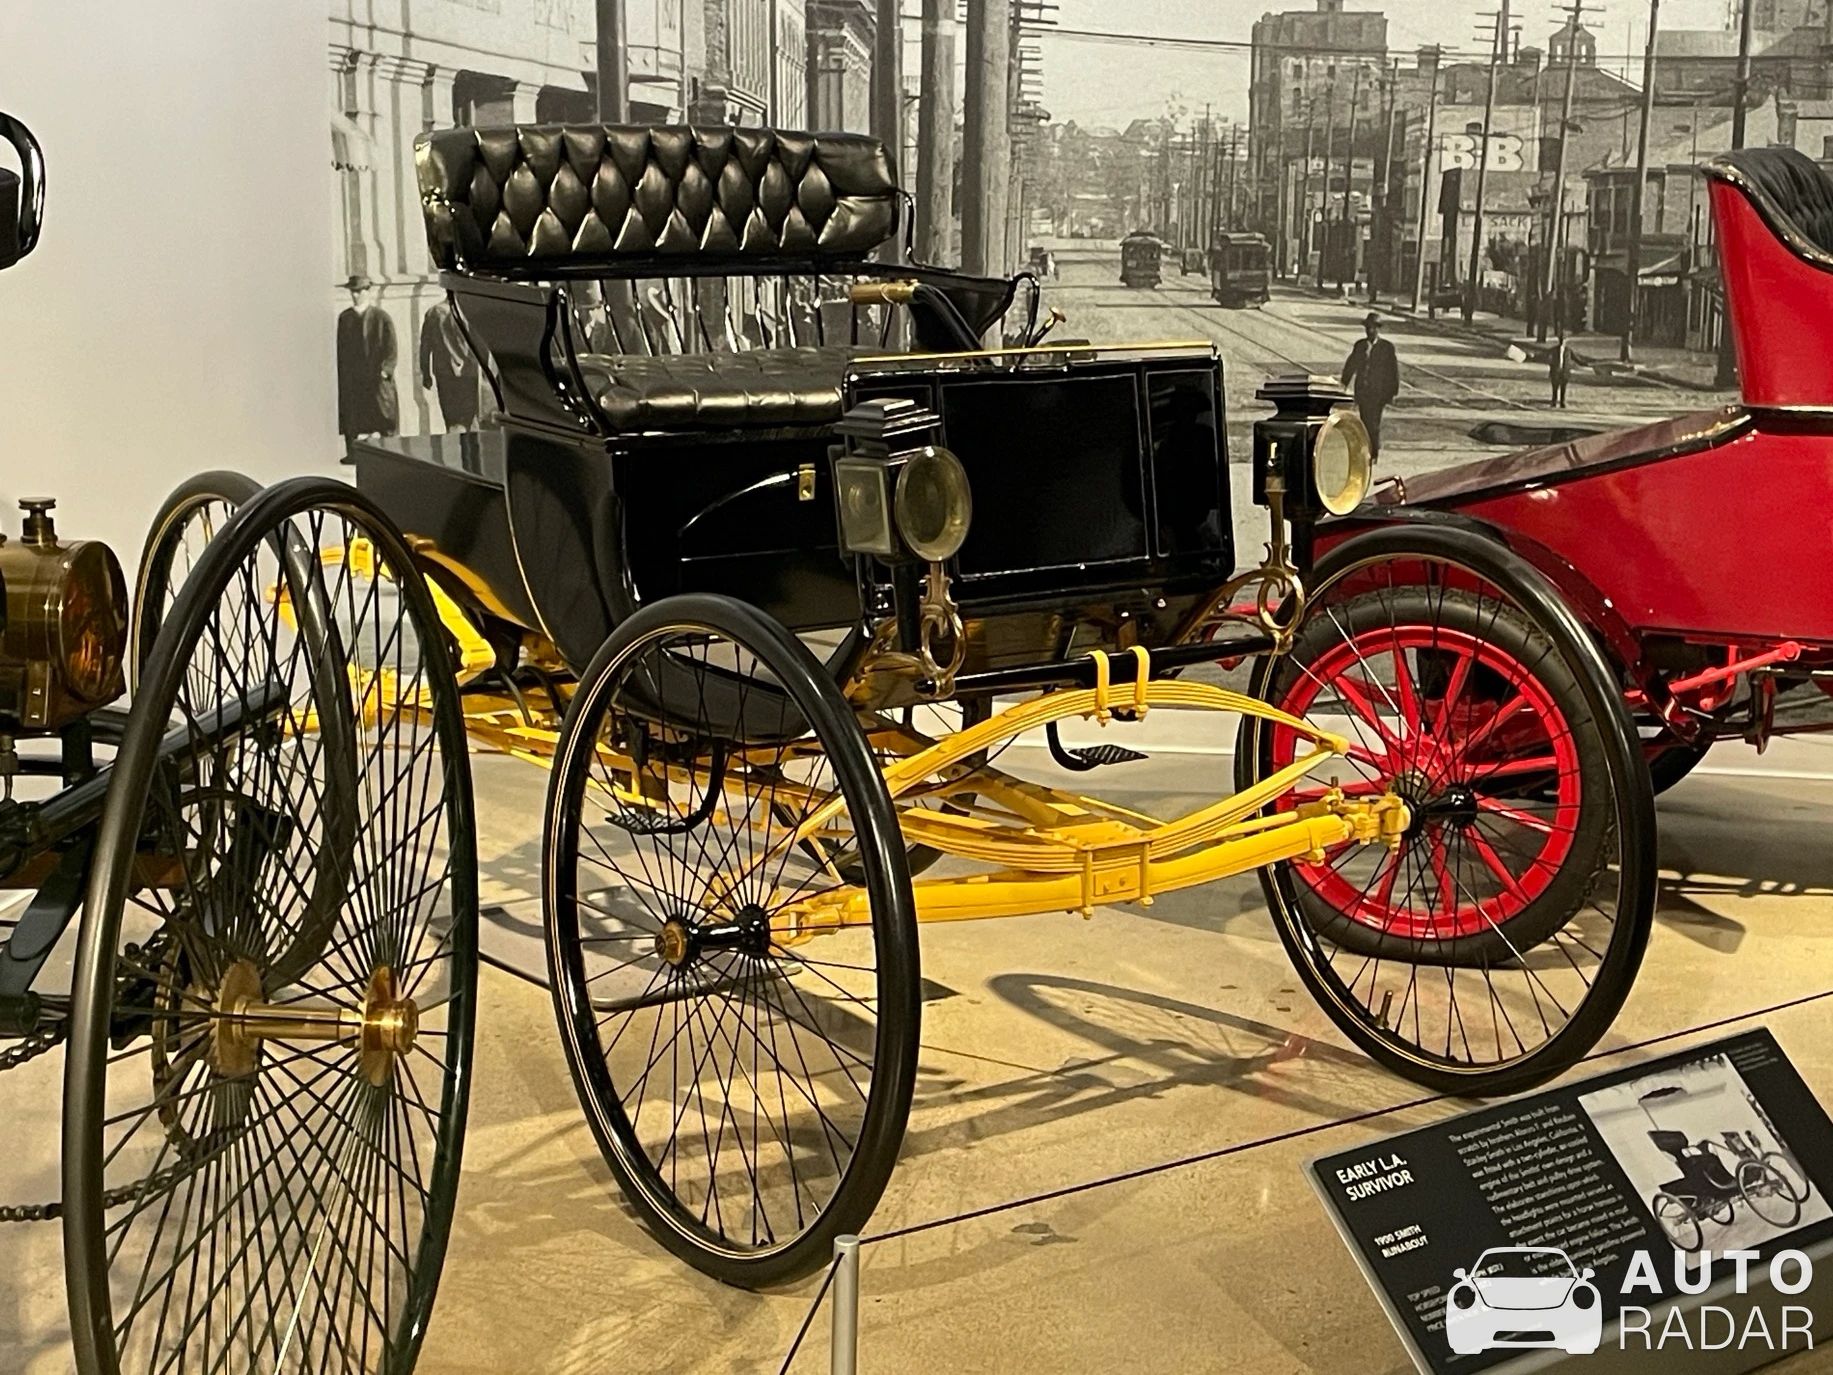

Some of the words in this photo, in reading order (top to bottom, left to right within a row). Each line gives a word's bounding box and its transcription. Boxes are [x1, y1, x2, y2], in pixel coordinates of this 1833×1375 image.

[1335, 1159, 1377, 1183] EARLY
[1377, 1153, 1407, 1170] L.A.
[1345, 1169, 1414, 1200] SURVIVOR
